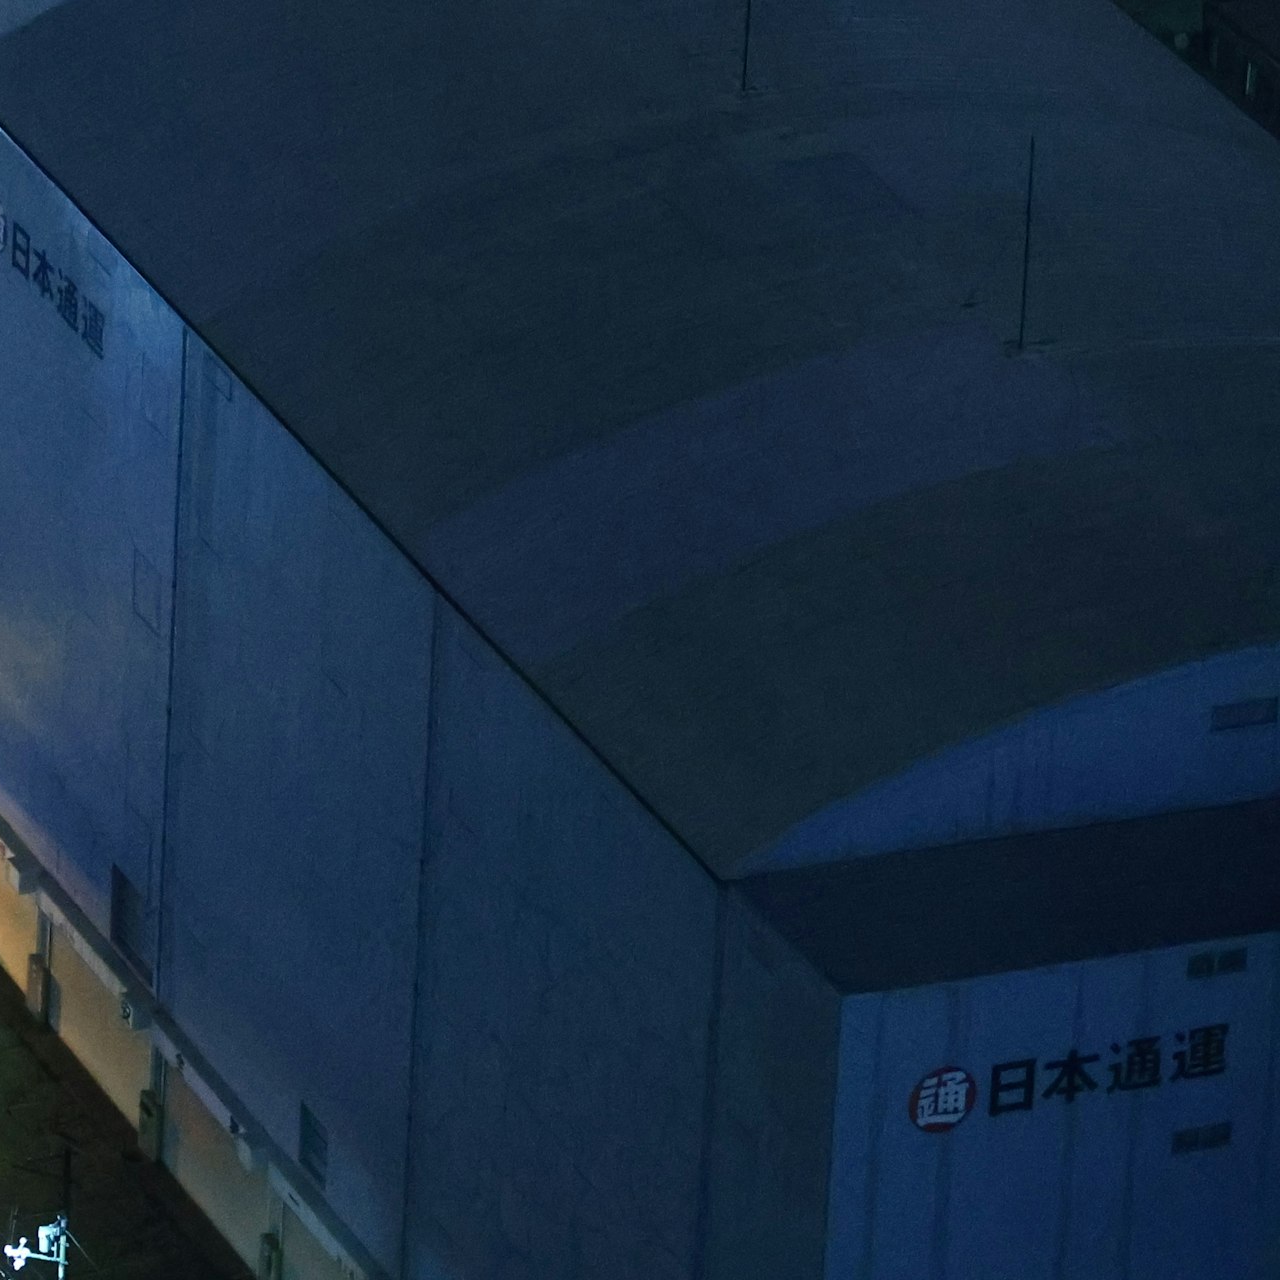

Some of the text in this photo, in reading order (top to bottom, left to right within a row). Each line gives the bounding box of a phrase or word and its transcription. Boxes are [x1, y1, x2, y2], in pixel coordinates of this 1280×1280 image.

[11, 221, 106, 360] 日本通運
[989, 1022, 1230, 1118] 日本通運
